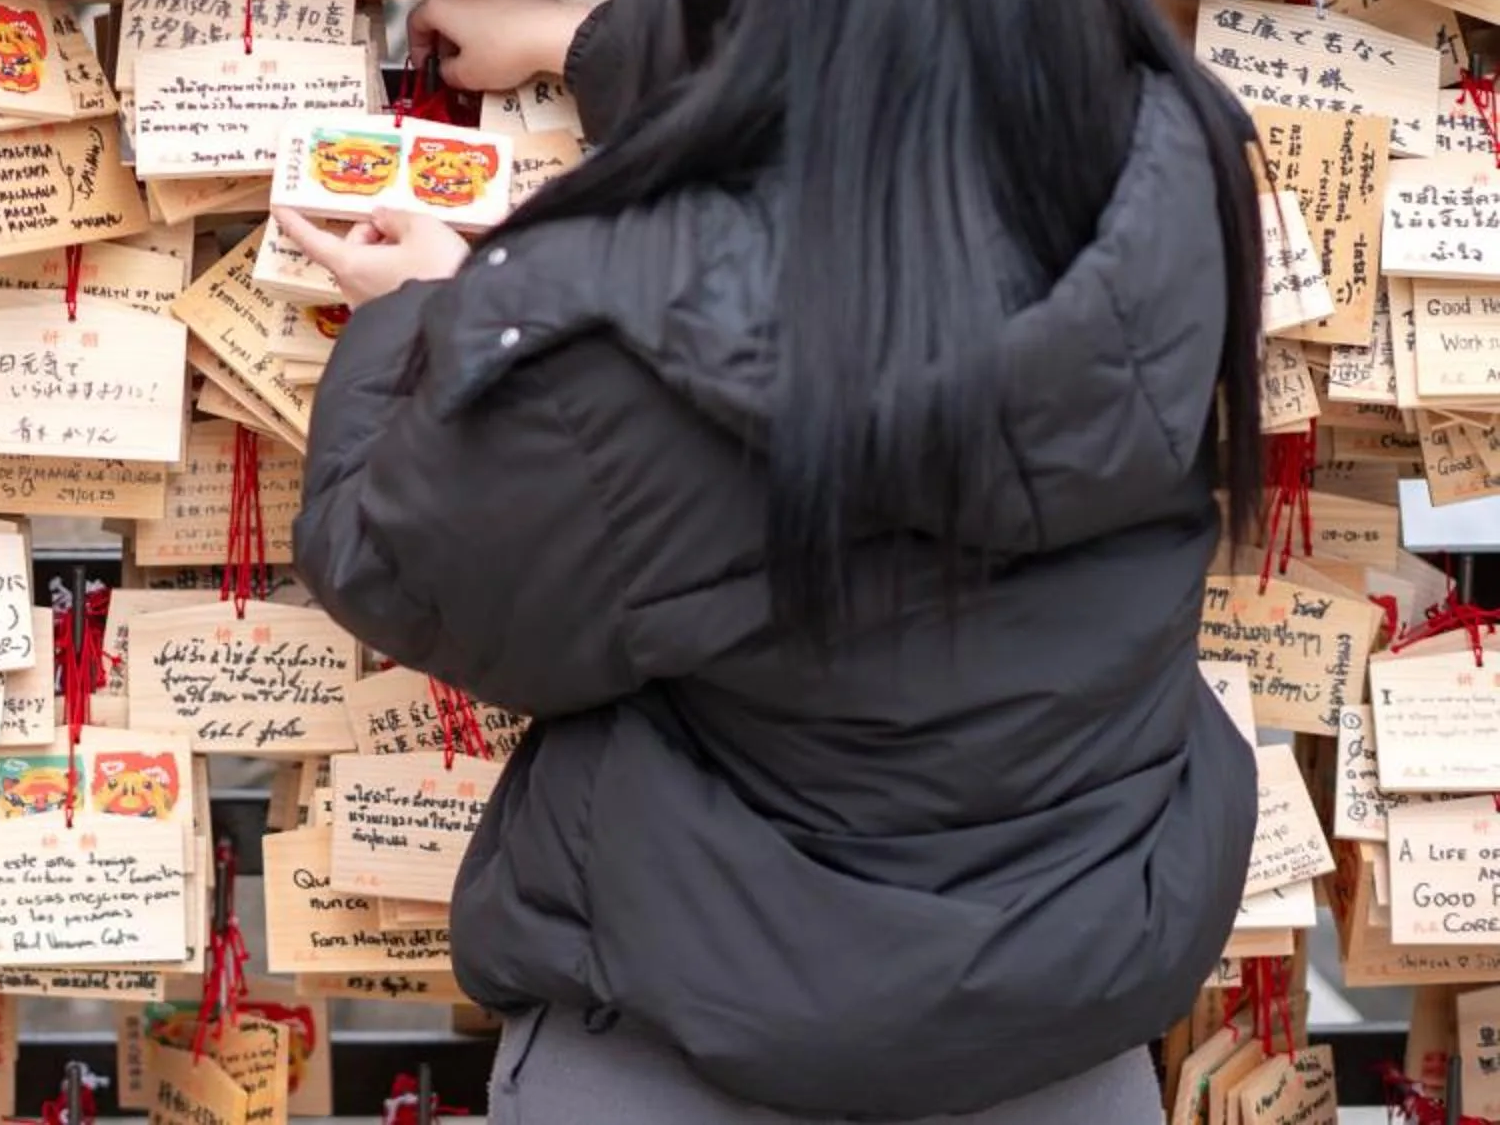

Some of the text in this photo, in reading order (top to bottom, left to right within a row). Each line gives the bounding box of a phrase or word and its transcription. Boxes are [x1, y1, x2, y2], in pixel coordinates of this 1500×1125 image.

[1426, 297, 1471, 317] Good
[1440, 333, 1482, 352] Work
[1399, 837, 1413, 863] A
[309, 896, 370, 910] nunca
